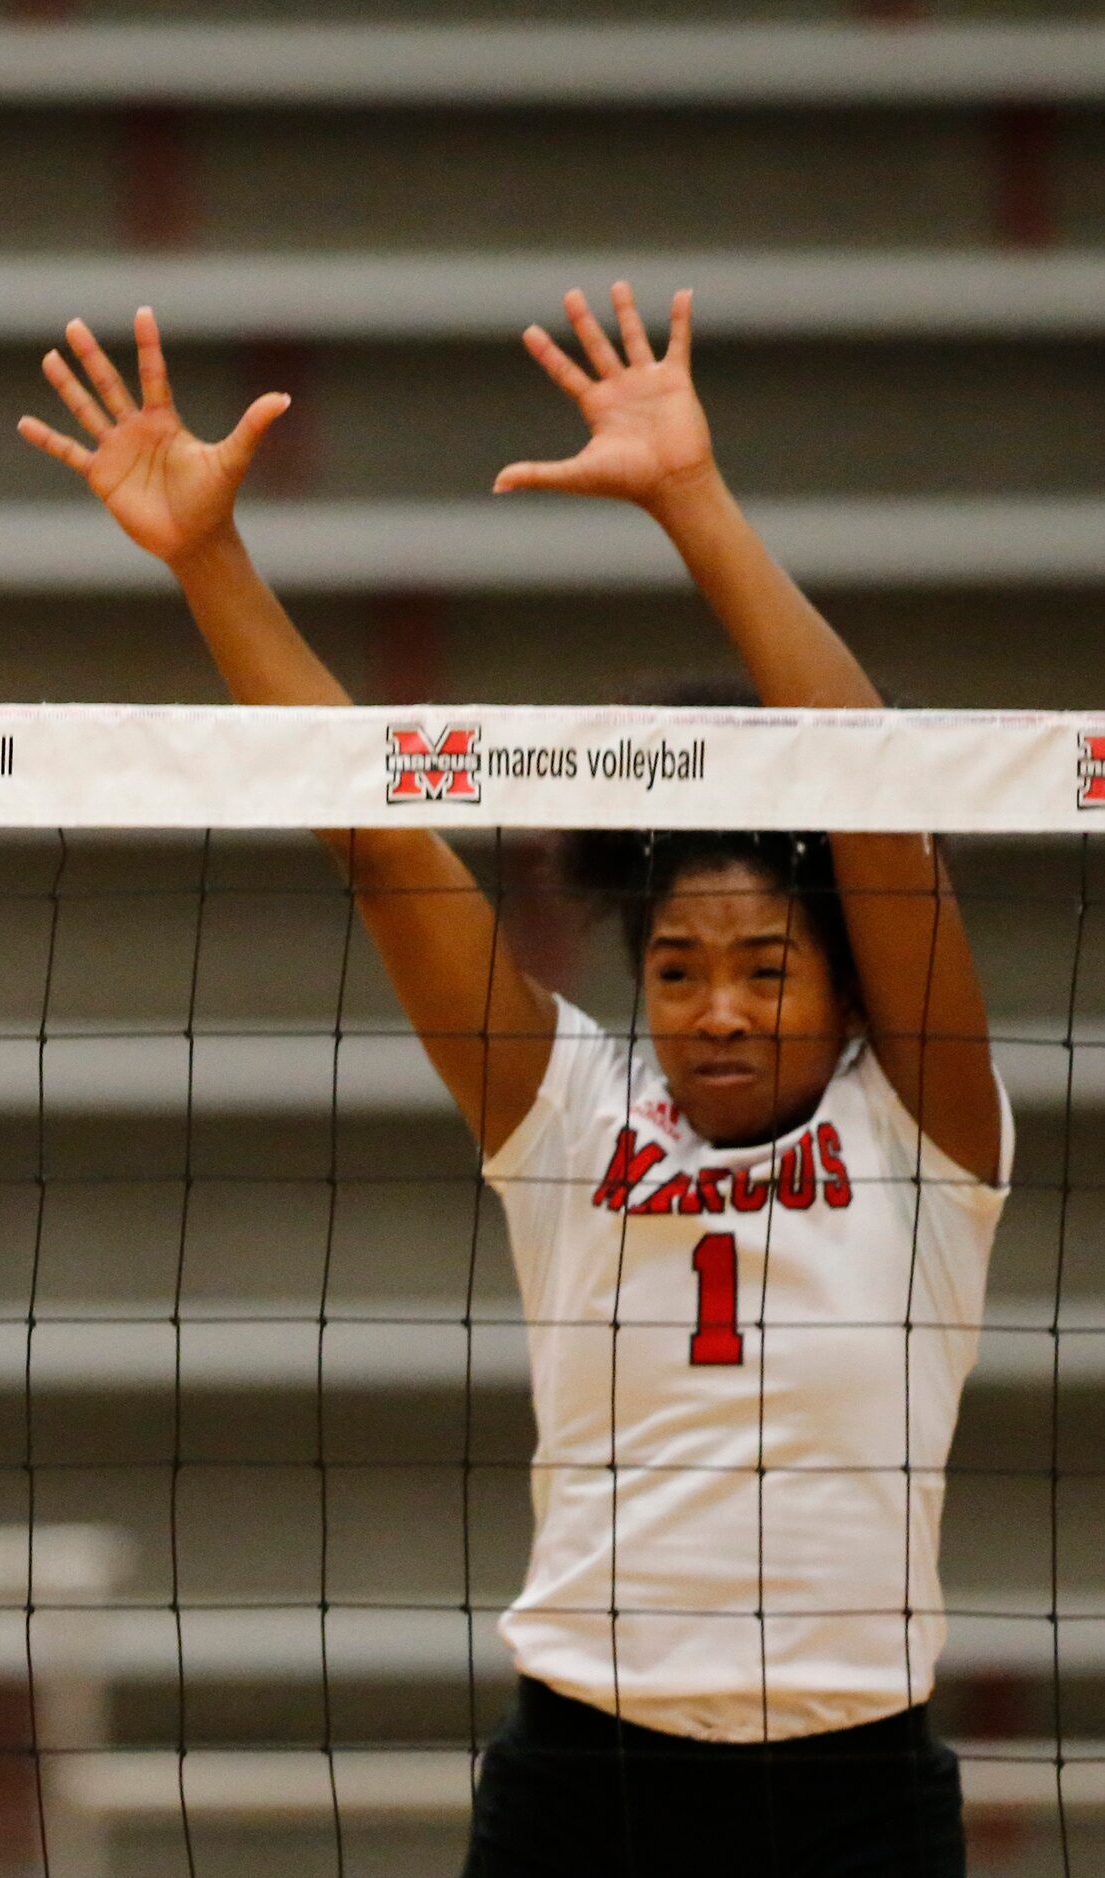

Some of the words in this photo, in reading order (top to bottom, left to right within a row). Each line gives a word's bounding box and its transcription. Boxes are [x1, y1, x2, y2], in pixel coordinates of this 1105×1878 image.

[488, 746, 578, 778] marcus
[587, 738, 705, 791] volleyball
[689, 1231, 744, 1366] 1
